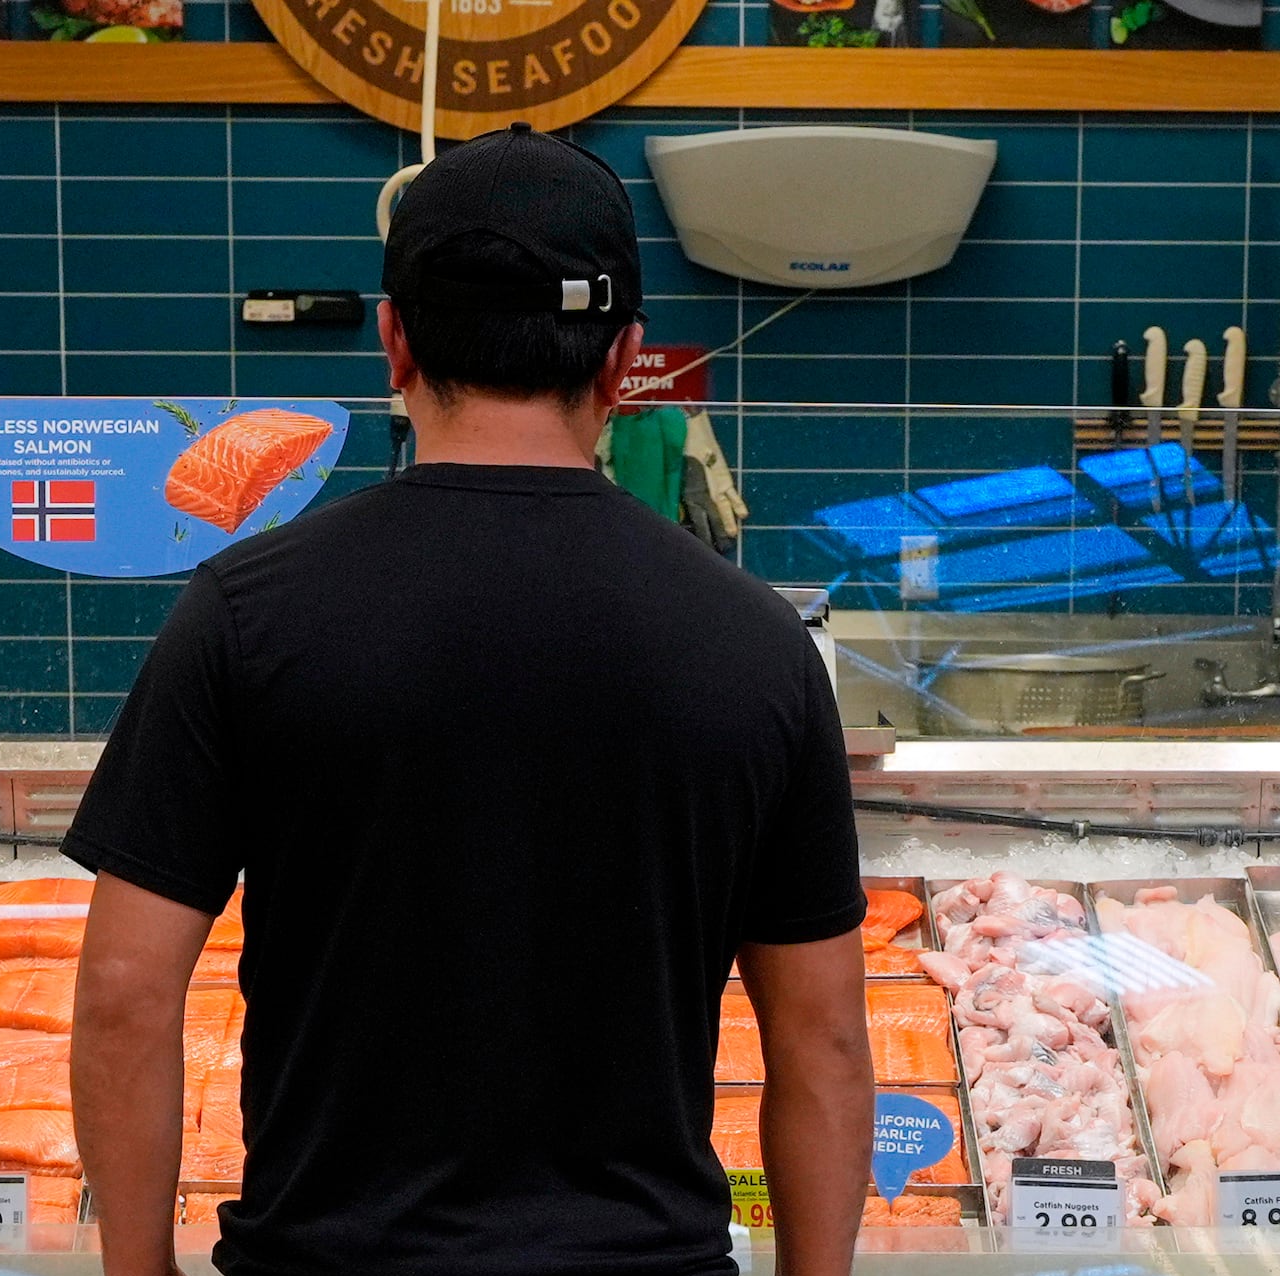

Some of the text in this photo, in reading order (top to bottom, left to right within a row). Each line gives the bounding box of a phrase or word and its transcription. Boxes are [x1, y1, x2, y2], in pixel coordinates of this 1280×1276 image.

[303, 0, 641, 94] ESH SEAFOO
[631, 353, 666, 368] OVE
[620, 375, 675, 390] ATION
[43, 420, 159, 434] NORWEGIAN
[14, 440, 92, 454] SALMON
[24, 458, 56, 466] without
[57, 458, 100, 466] antibiotics
[102, 458, 111, 466] or
[25, 468, 41, 477] and
[43, 468, 89, 477] sustainably
[91, 468, 126, 477] sourced.
[1042, 1165, 1082, 1176] FRESH
[729, 1175, 768, 1186] SALE
[1034, 1201, 1099, 1211] Catfish Nuggets
[1244, 1196, 1273, 1205] Catfish
